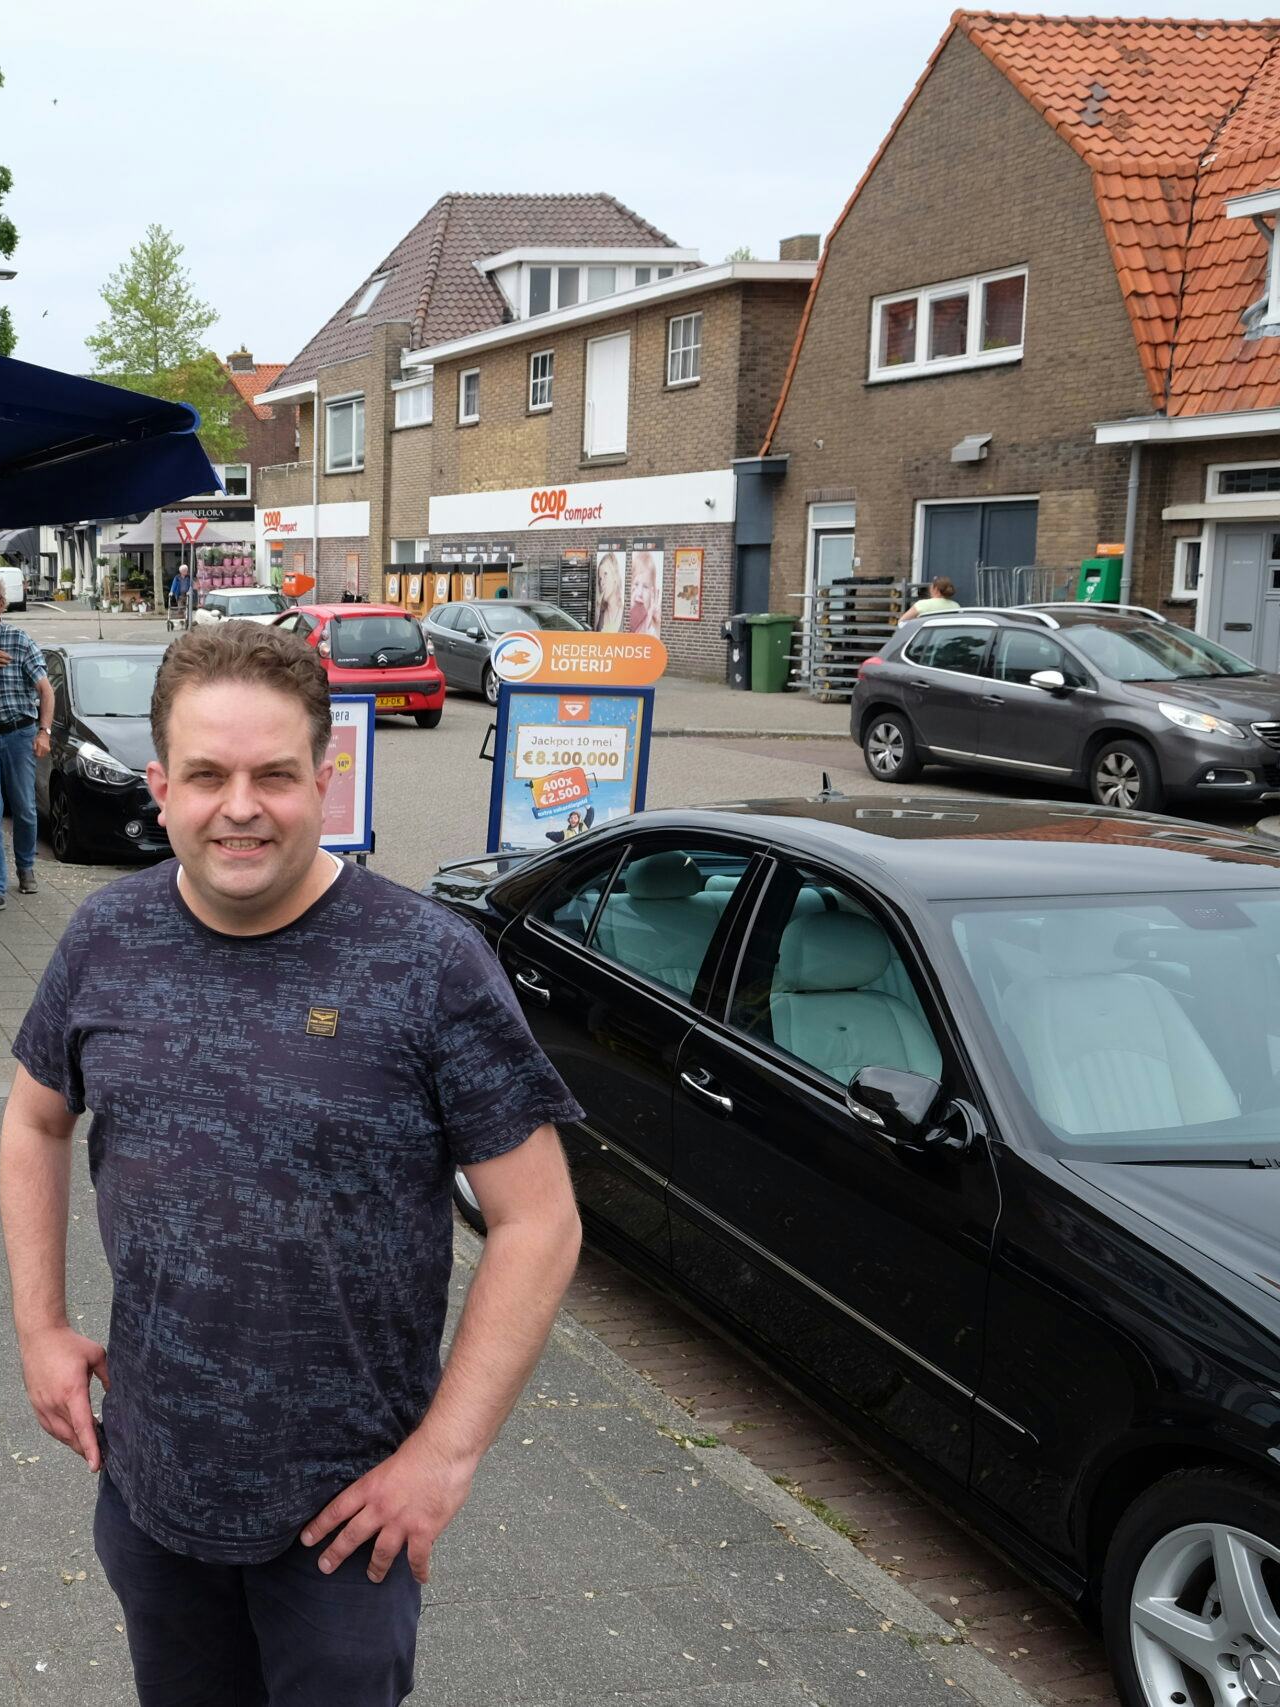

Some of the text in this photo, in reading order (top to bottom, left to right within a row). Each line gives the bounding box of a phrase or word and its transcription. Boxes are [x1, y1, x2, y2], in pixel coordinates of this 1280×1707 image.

[564, 503, 603, 524] compact
[551, 644, 652, 659] NEDERLANDSE
[550, 658, 613, 673] LOTERIJ
[531, 736, 613, 747] Jackpot 10 mei
[542, 776, 573, 792] 400x
[540, 785, 581, 805] €2.500
